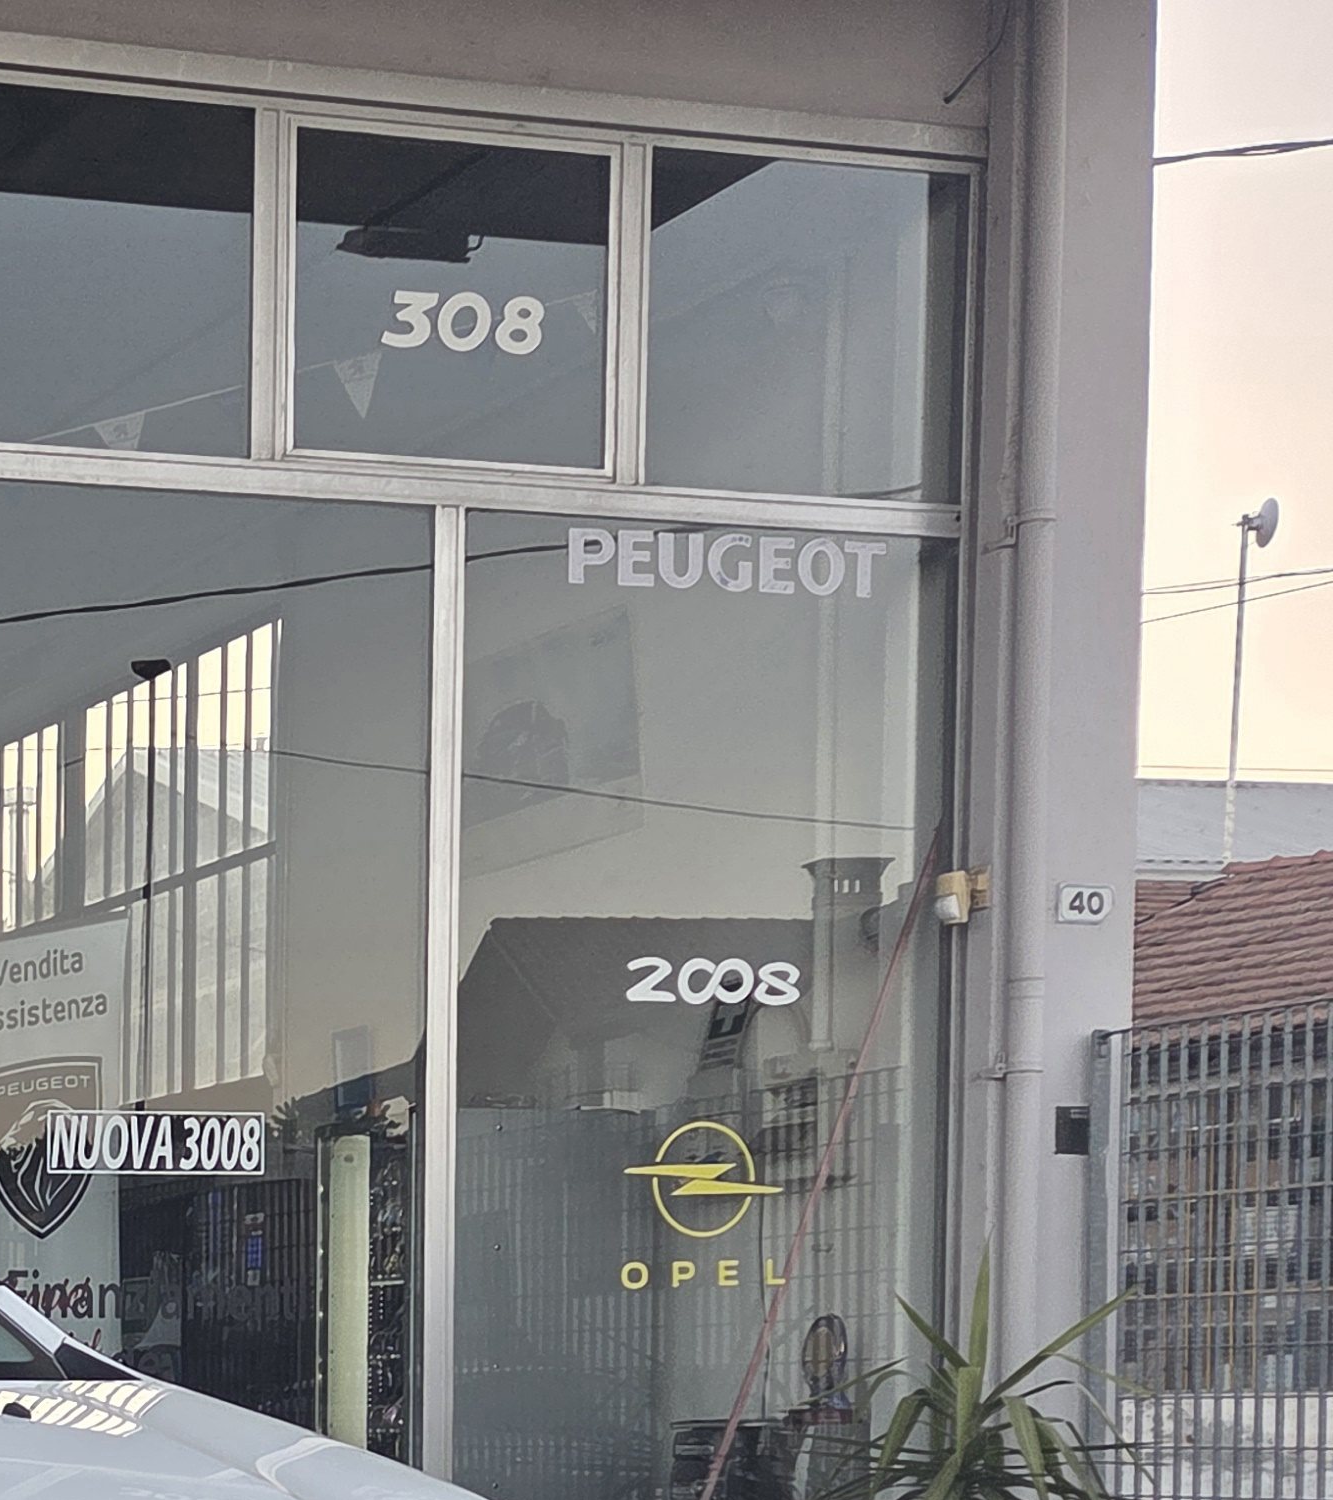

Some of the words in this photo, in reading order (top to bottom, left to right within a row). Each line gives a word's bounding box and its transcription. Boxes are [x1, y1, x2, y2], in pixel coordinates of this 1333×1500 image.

[381, 290, 545, 355] 308
[568, 527, 887, 599] PEUGEOT
[1069, 891, 1104, 916] 40
[626, 956, 800, 1006] 2008
[50, 1114, 175, 1171] NUOVA
[179, 1116, 261, 1171] 3008
[621, 1258, 786, 1290] OPEL
